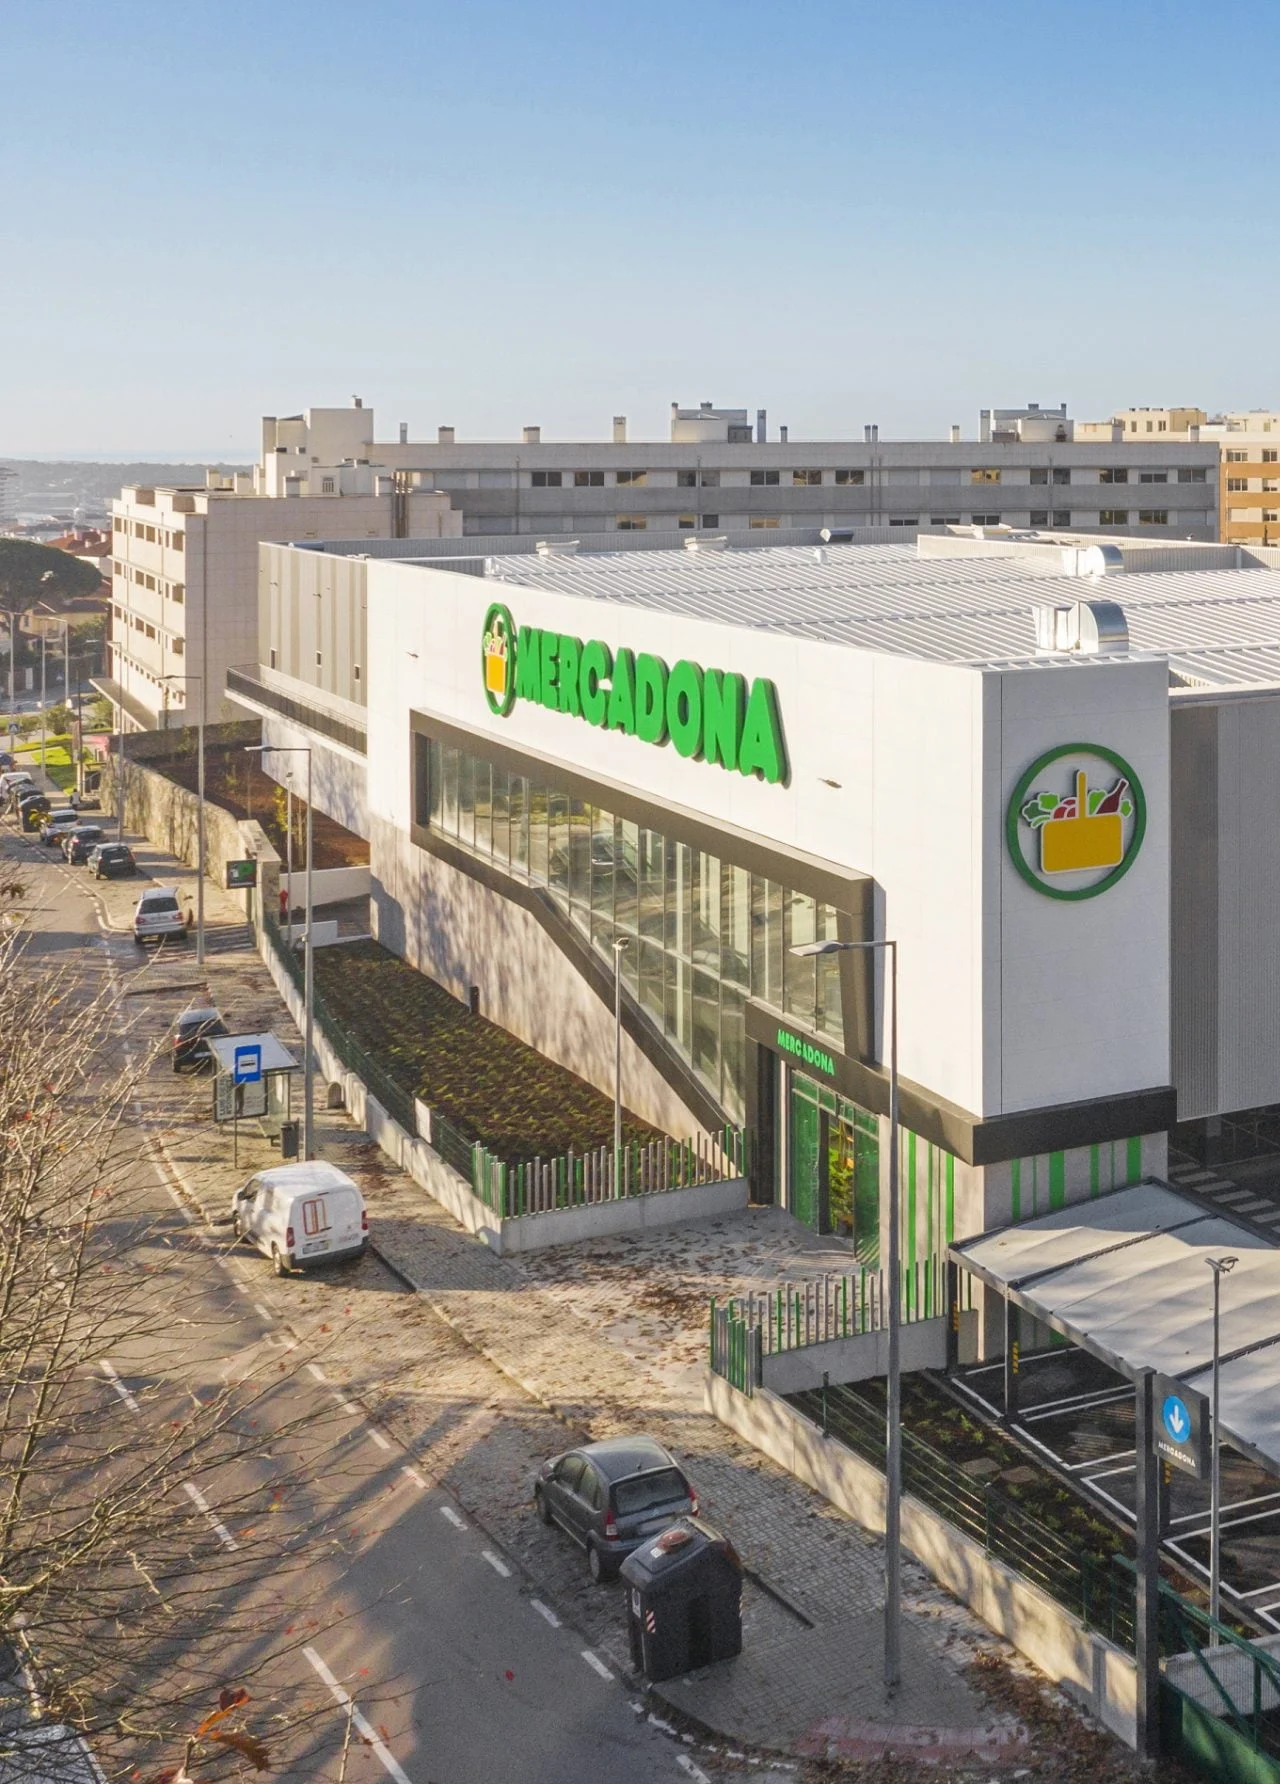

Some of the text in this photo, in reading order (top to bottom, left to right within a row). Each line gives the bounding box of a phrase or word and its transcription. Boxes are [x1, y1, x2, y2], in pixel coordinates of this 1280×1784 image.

[516, 625, 788, 786] MERCADONA
[777, 1028, 835, 1076] MERCADONA
[1158, 1440, 1196, 1468] MERCADONA
